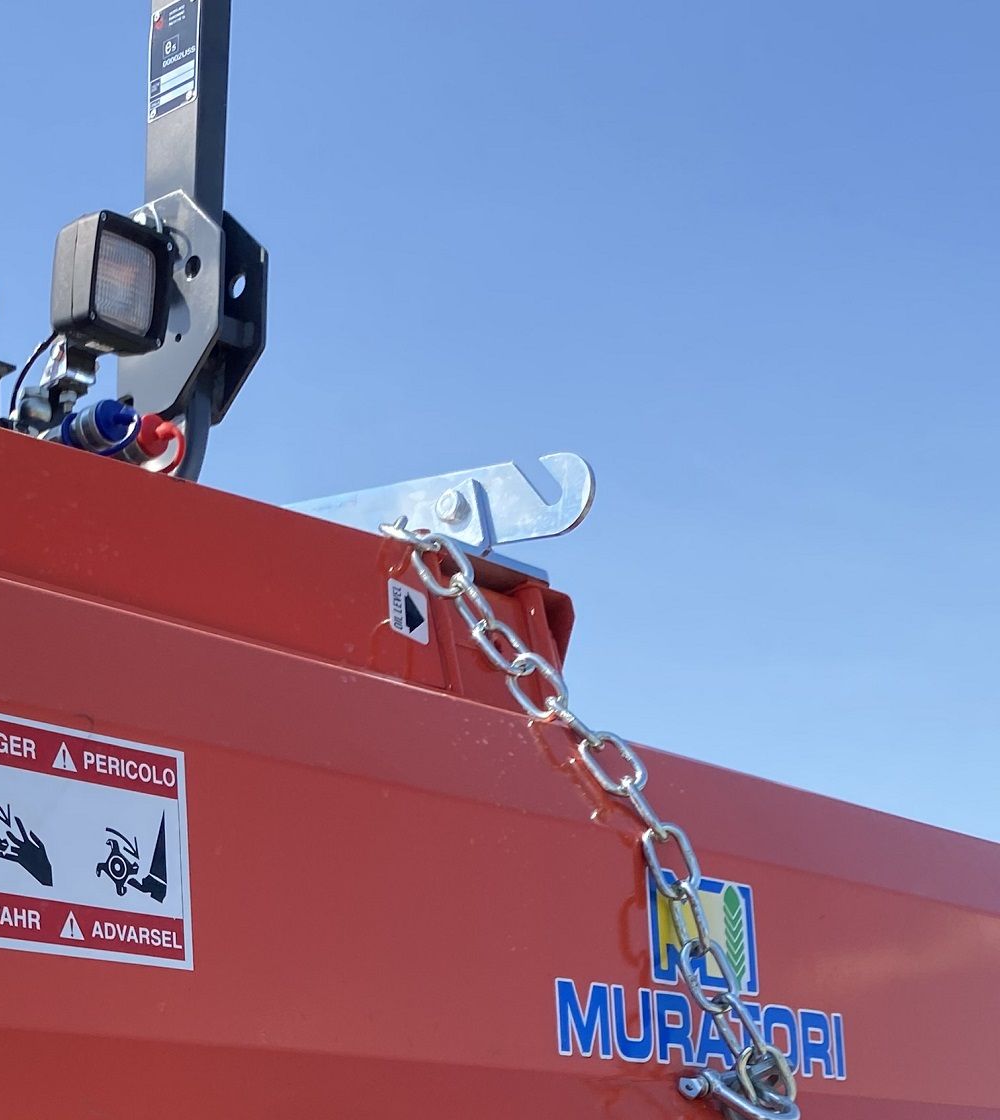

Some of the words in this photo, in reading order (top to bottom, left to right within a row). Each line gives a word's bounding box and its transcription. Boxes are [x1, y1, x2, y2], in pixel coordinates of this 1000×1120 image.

[392, 586, 403, 614] LEVEL
[393, 616, 403, 630] OIL
[83, 751, 176, 788] PERICOLO
[91, 920, 183, 950] ADVARSEL
[556, 977, 847, 1081] MURATORI
